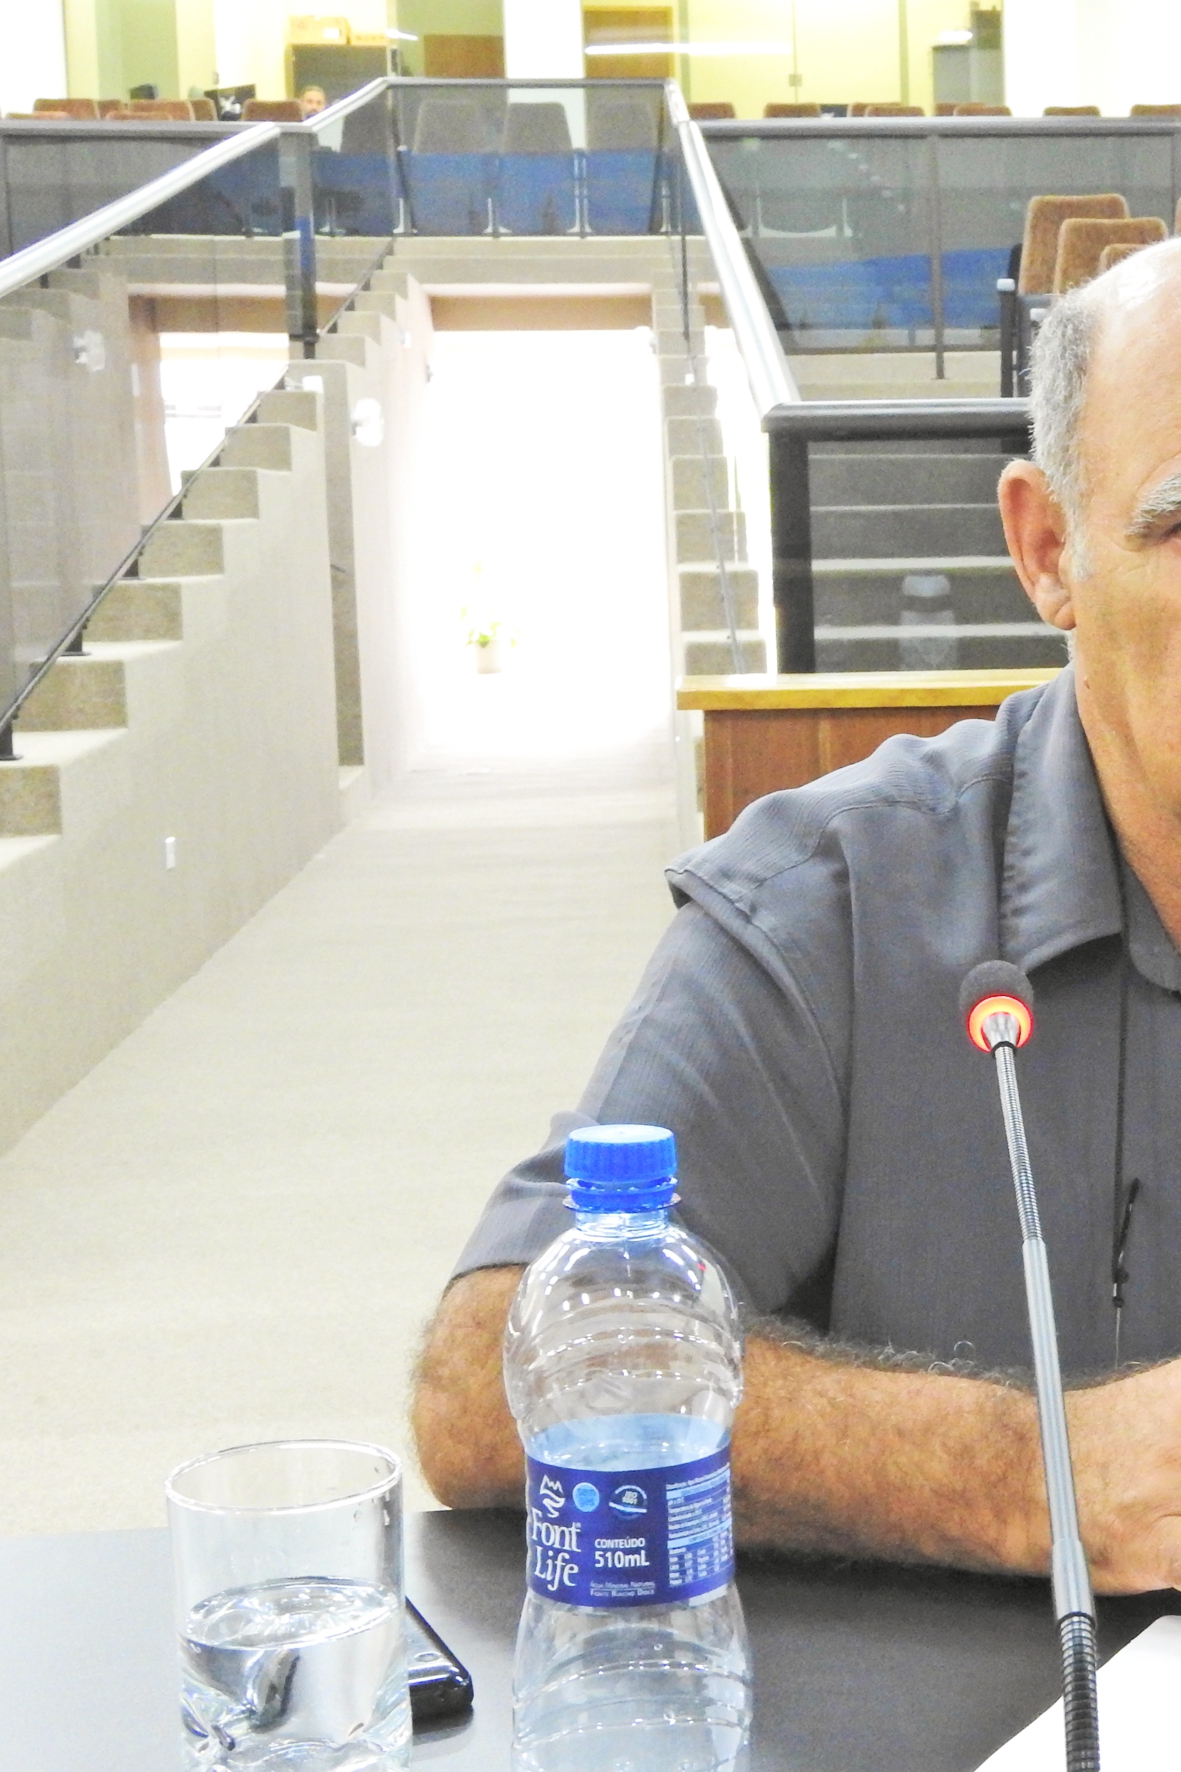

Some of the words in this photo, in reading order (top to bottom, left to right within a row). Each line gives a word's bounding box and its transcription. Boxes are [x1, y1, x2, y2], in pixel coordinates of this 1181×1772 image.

[531, 1507, 582, 1552] Font
[594, 1536, 645, 1548] CONTEÚDO
[534, 1545, 579, 1591] Life
[594, 1550, 650, 1568] 510mL
